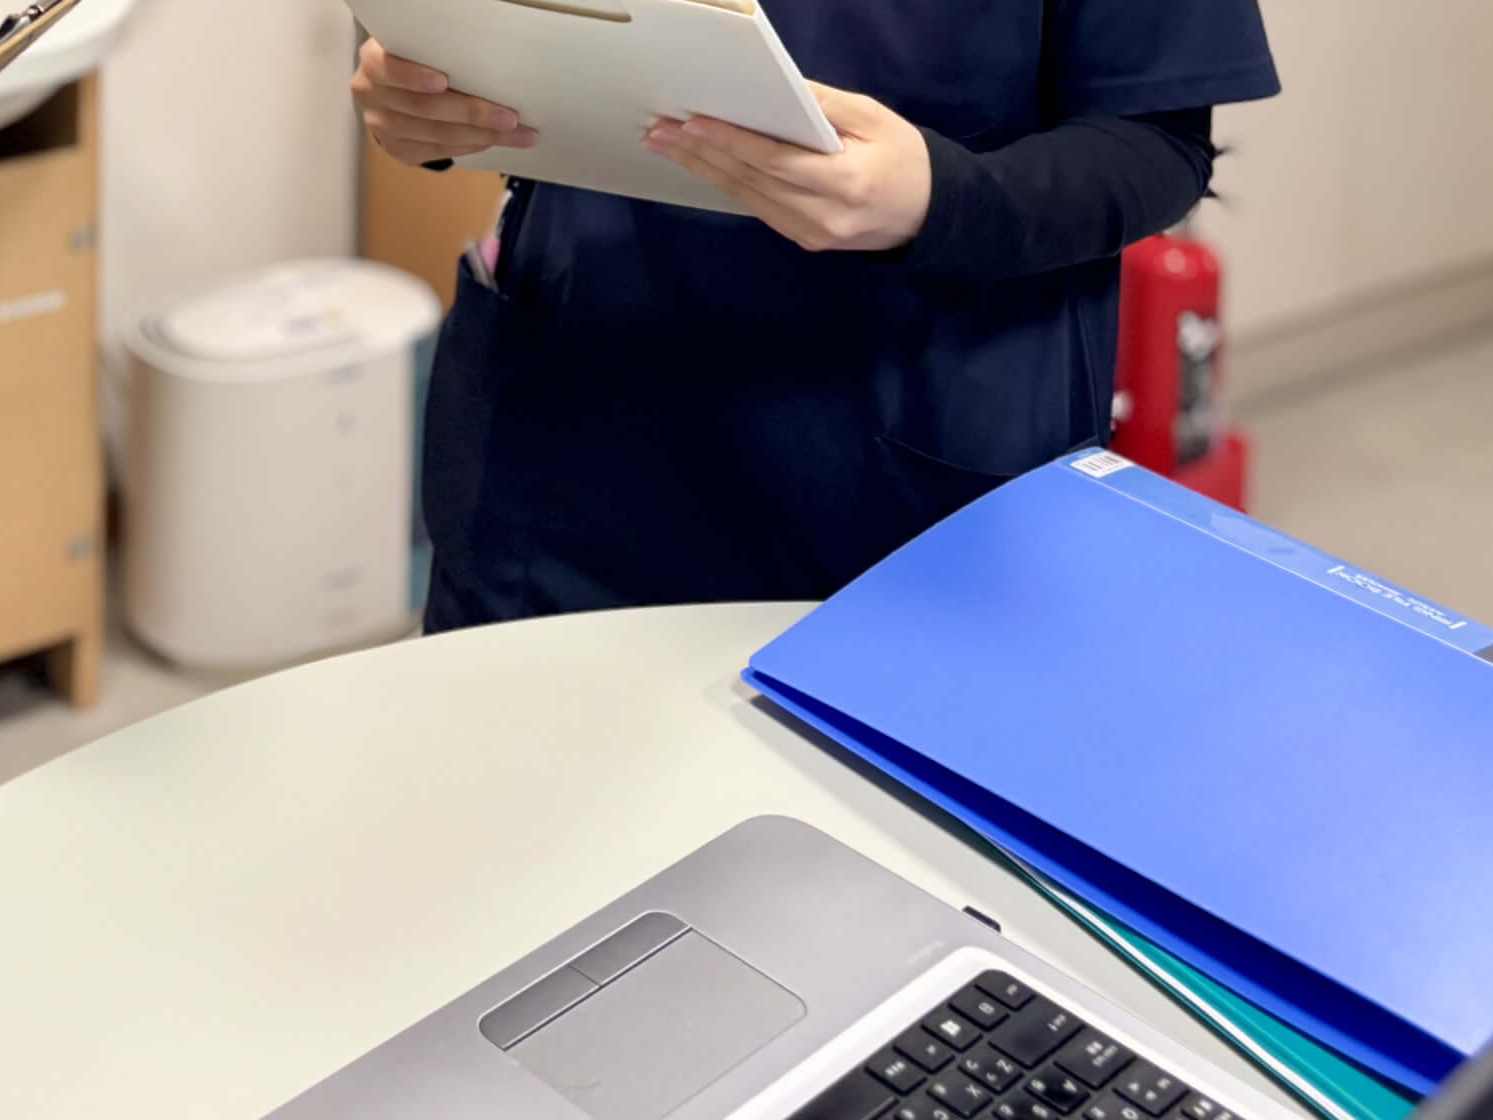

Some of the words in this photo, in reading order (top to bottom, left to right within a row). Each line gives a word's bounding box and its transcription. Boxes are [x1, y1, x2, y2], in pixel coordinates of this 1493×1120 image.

[996, 1058, 1013, 1073] Z
[965, 1083, 982, 1098] X
[1062, 1079, 1078, 1094] A
